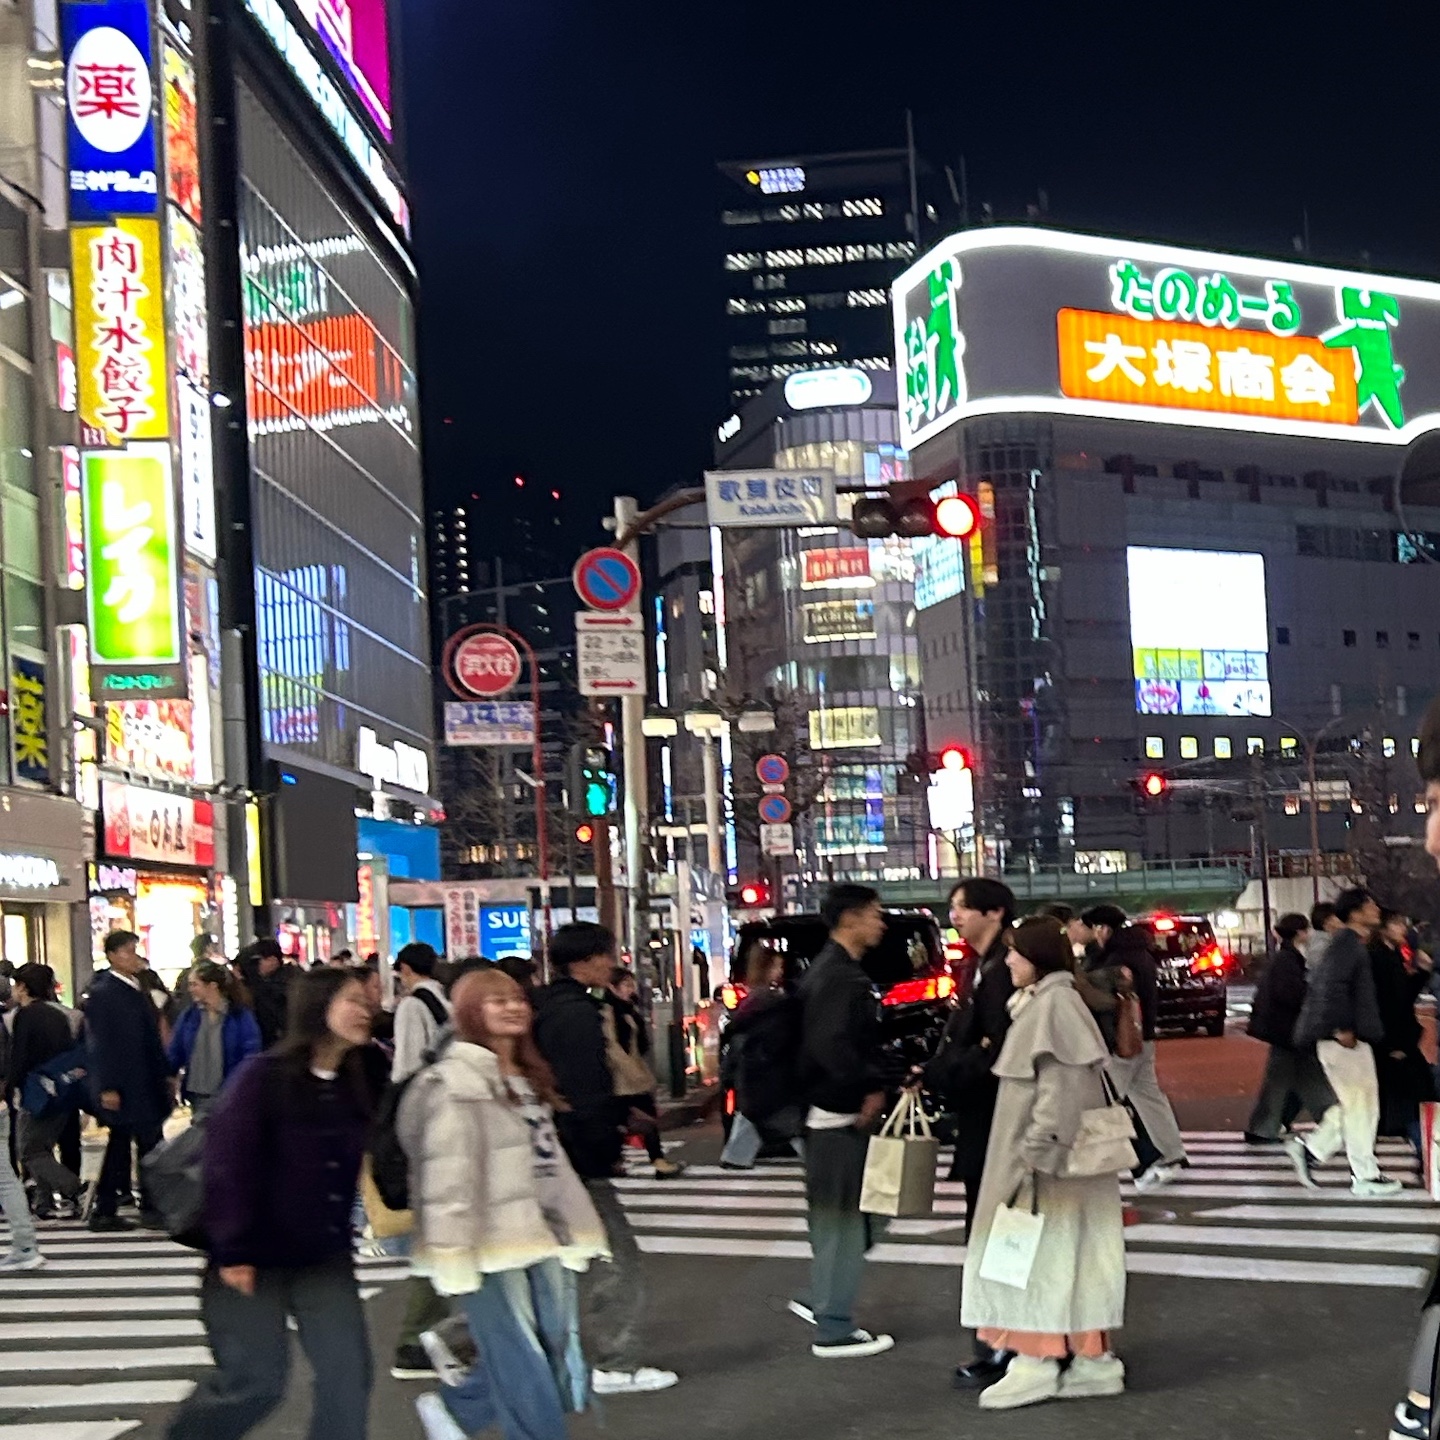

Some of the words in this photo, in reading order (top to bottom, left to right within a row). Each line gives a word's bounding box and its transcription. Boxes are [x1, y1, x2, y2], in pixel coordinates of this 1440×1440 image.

[75, 63, 141, 119] 薬
[1110, 260, 1301, 337] たのめーる
[96, 236, 148, 435] 肉汁水餃子
[1084, 334, 1337, 406] 大塚商会
[718, 476, 822, 501] 歌舞伎町
